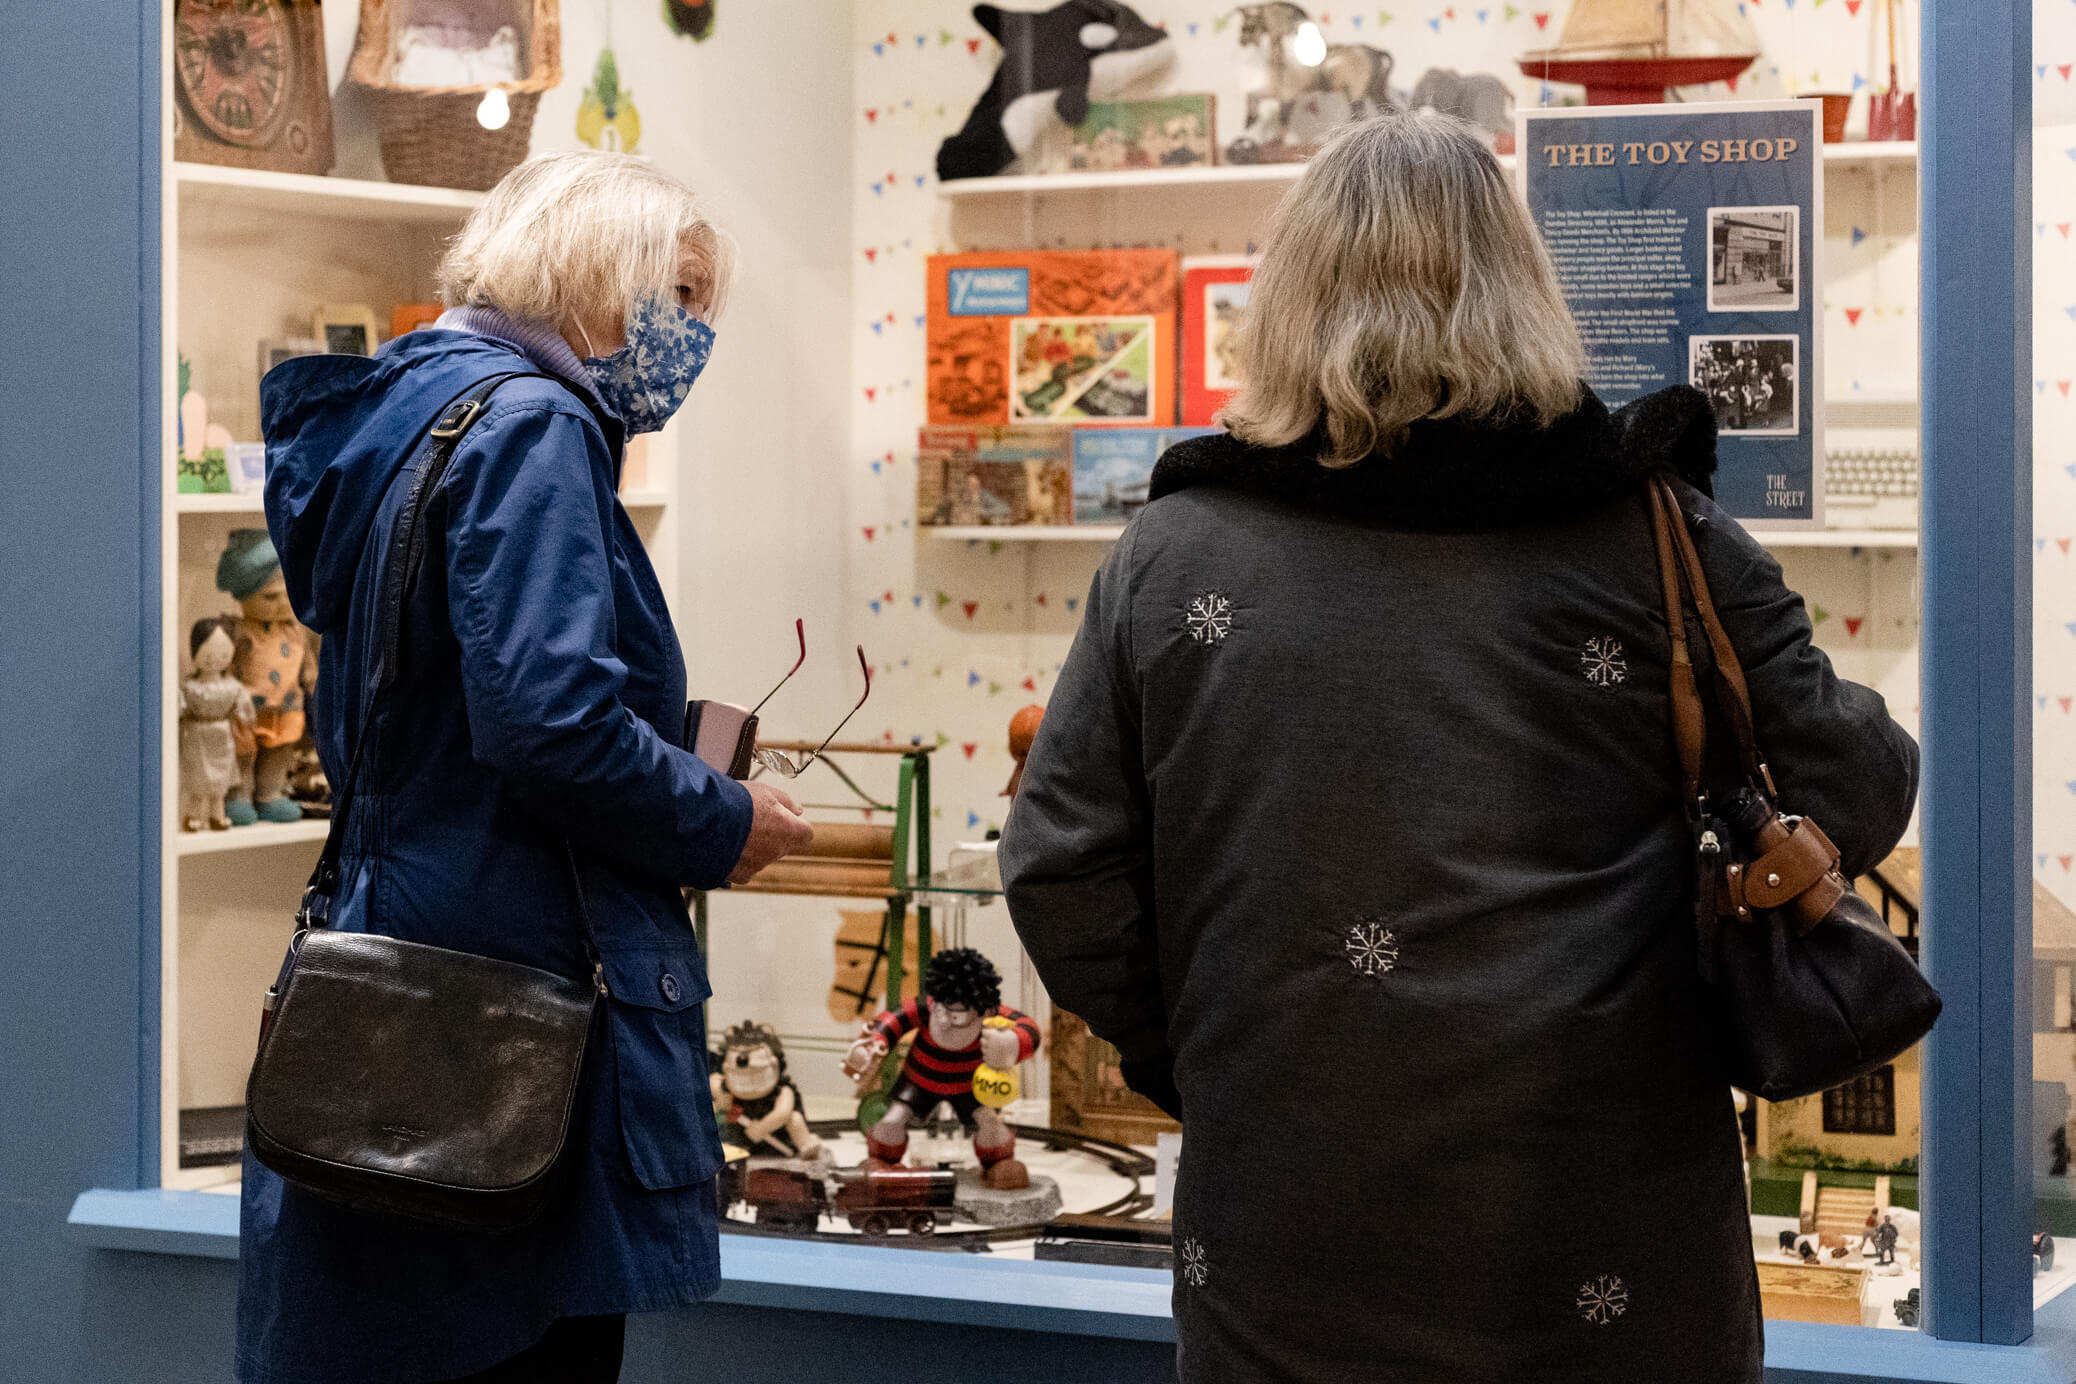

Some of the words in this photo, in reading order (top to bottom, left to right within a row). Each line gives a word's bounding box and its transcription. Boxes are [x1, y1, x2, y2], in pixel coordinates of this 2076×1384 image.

[1544, 144, 1615, 166] THE
[1623, 141, 1693, 164] TOY
[1700, 138, 1797, 162] SHOP
[1767, 473, 1787, 490] THE
[1765, 489, 1805, 509] STREET
